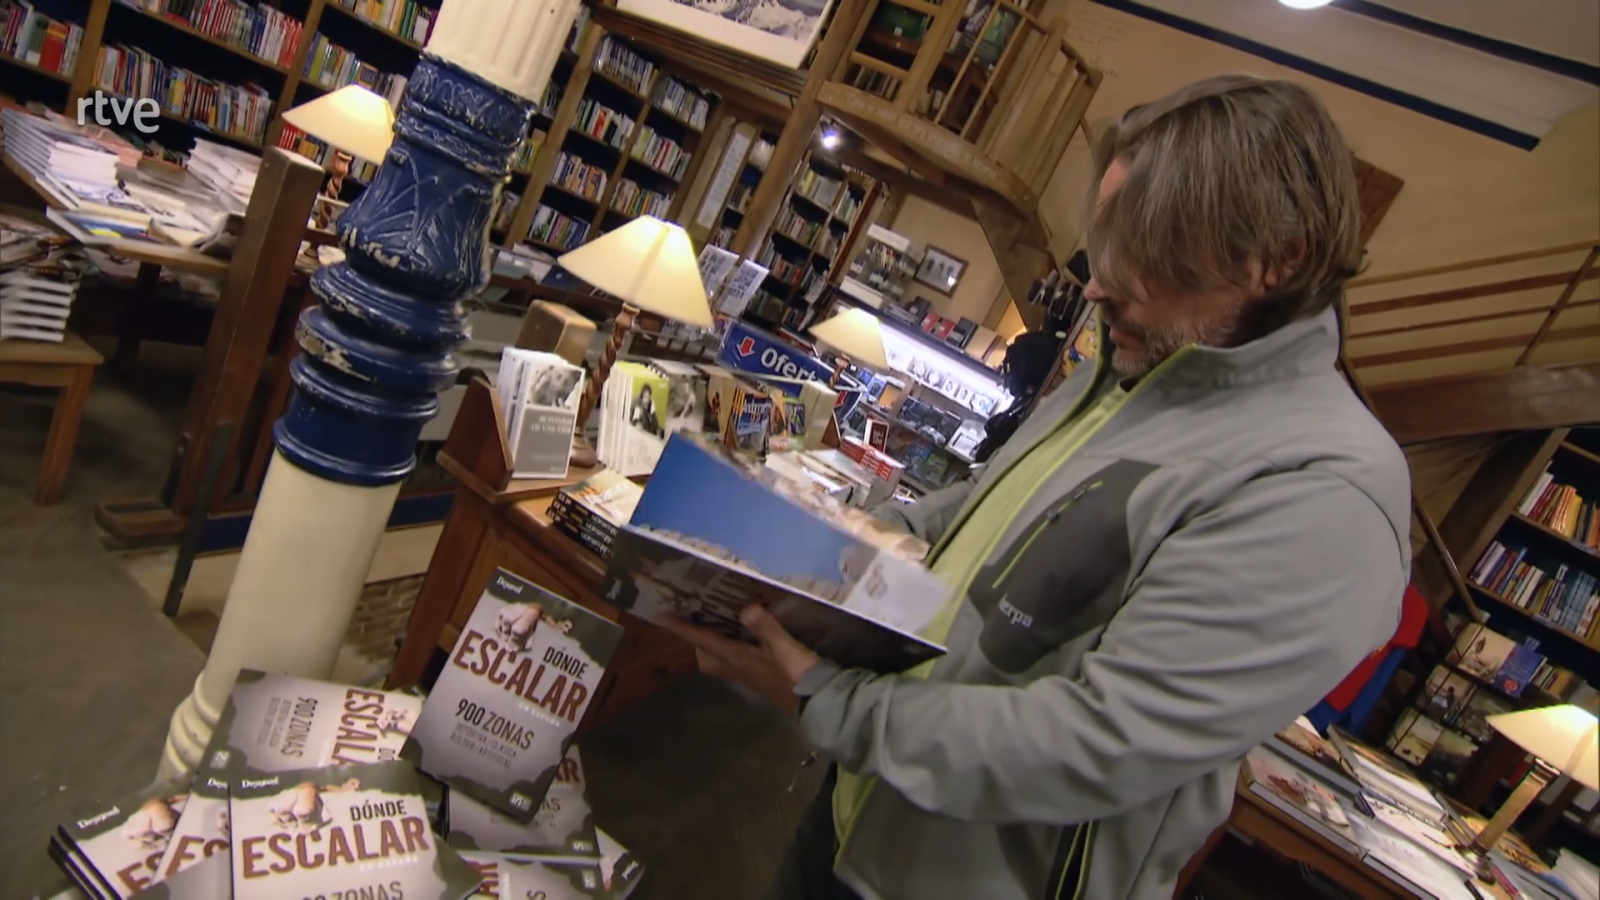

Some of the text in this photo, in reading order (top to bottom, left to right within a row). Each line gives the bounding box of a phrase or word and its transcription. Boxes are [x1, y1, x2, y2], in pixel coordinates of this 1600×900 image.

[760, 347, 818, 382] Ofert
[453, 629, 588, 723] ESCALAR
[543, 646, 589, 681] DÓNDE
[280, 717, 312, 759] ZONAS
[332, 688, 386, 766] ESCALA
[455, 698, 534, 751] 900 ZONAS
[350, 799, 408, 822] DÓNDE
[241, 816, 431, 879] ESCALAR
[331, 880, 404, 900] NAS
